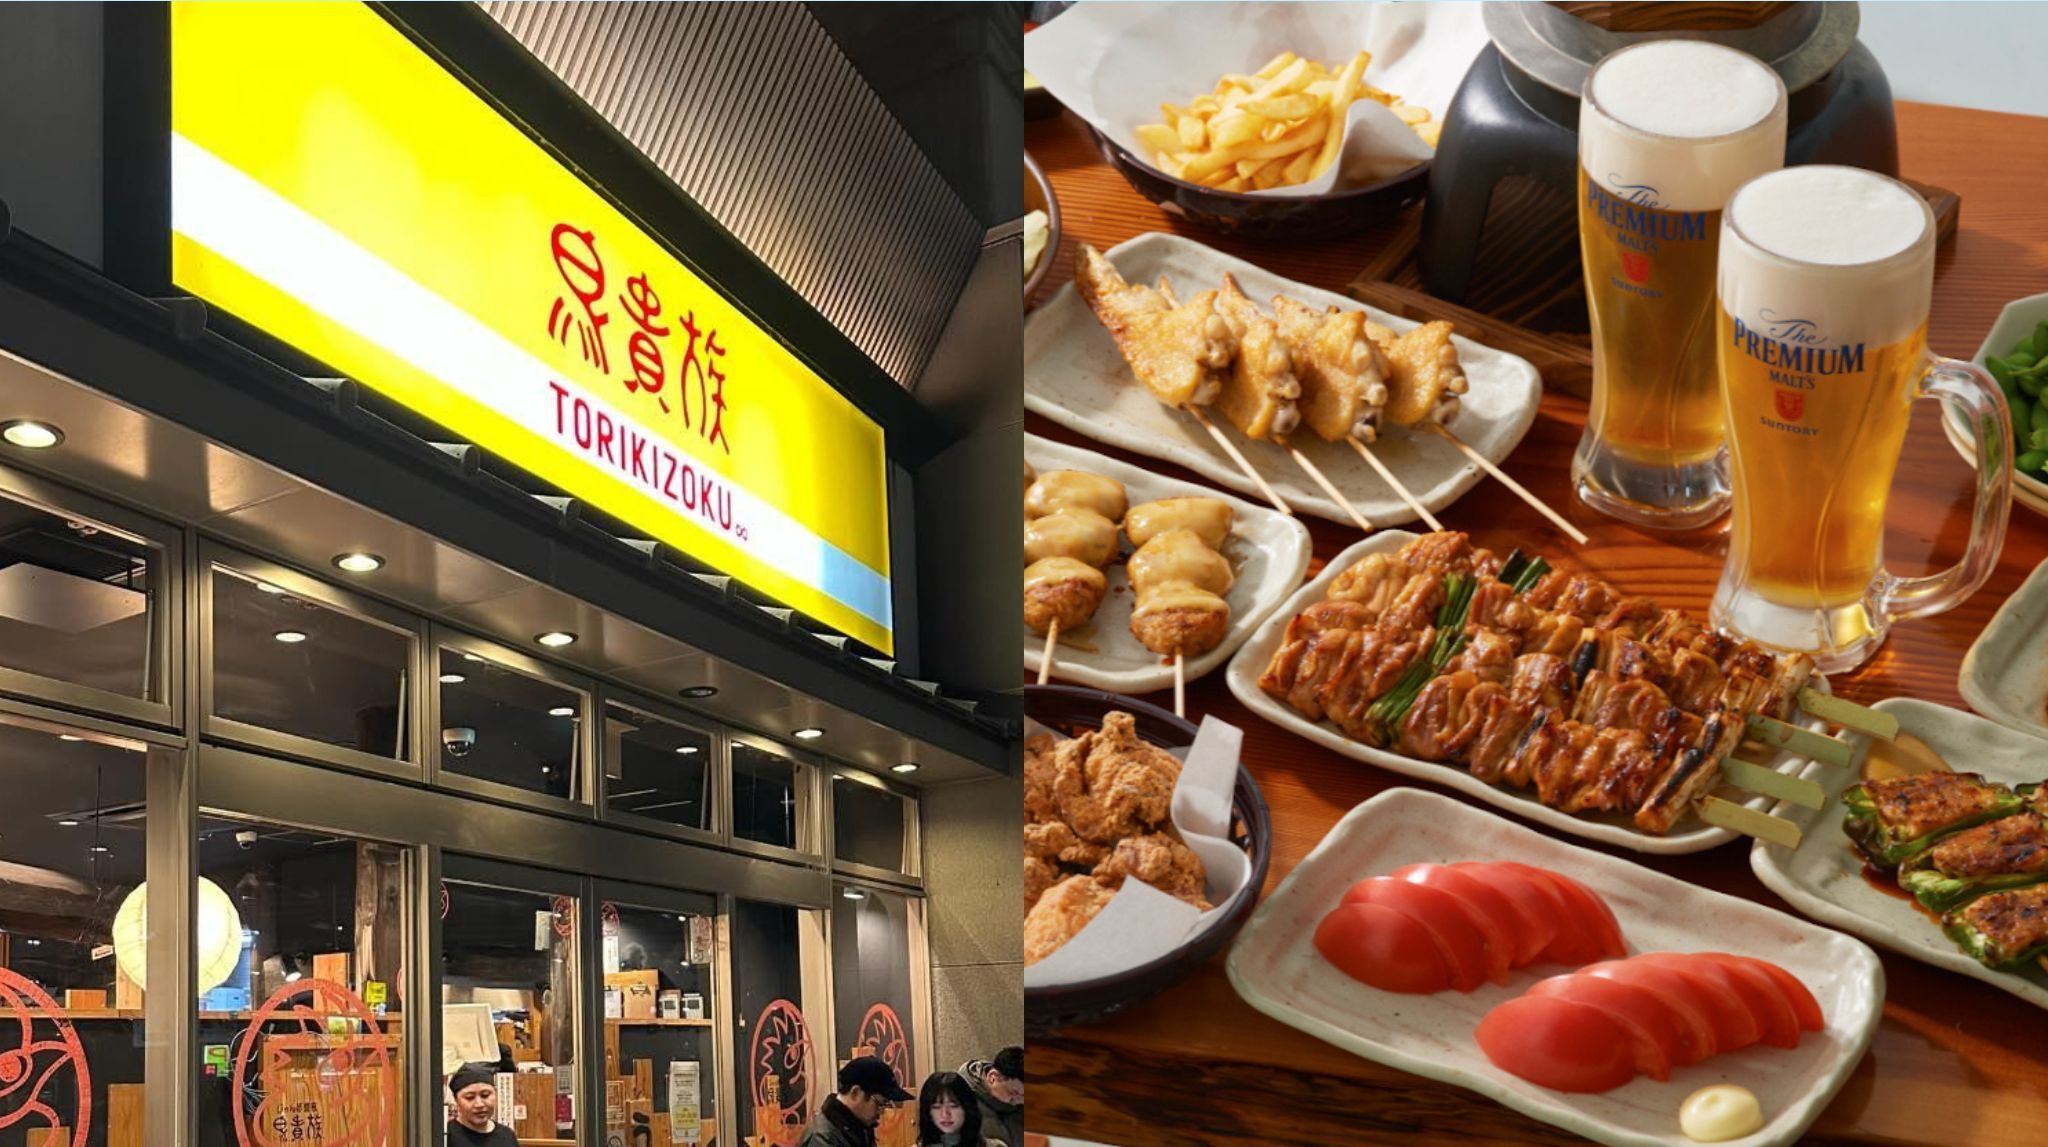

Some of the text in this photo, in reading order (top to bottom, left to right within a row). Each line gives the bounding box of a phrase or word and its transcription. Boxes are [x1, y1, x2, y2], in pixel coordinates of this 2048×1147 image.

[1608, 172, 1670, 208] The
[1587, 177, 1706, 241] PREMIUM
[1760, 308, 1827, 344] The
[1733, 316, 1865, 375] PREMIUM
[1769, 371, 1816, 390] MALT'S
[1760, 416, 1819, 436] SUNTORY
[549, 381, 733, 530] TORIKIZOKU
